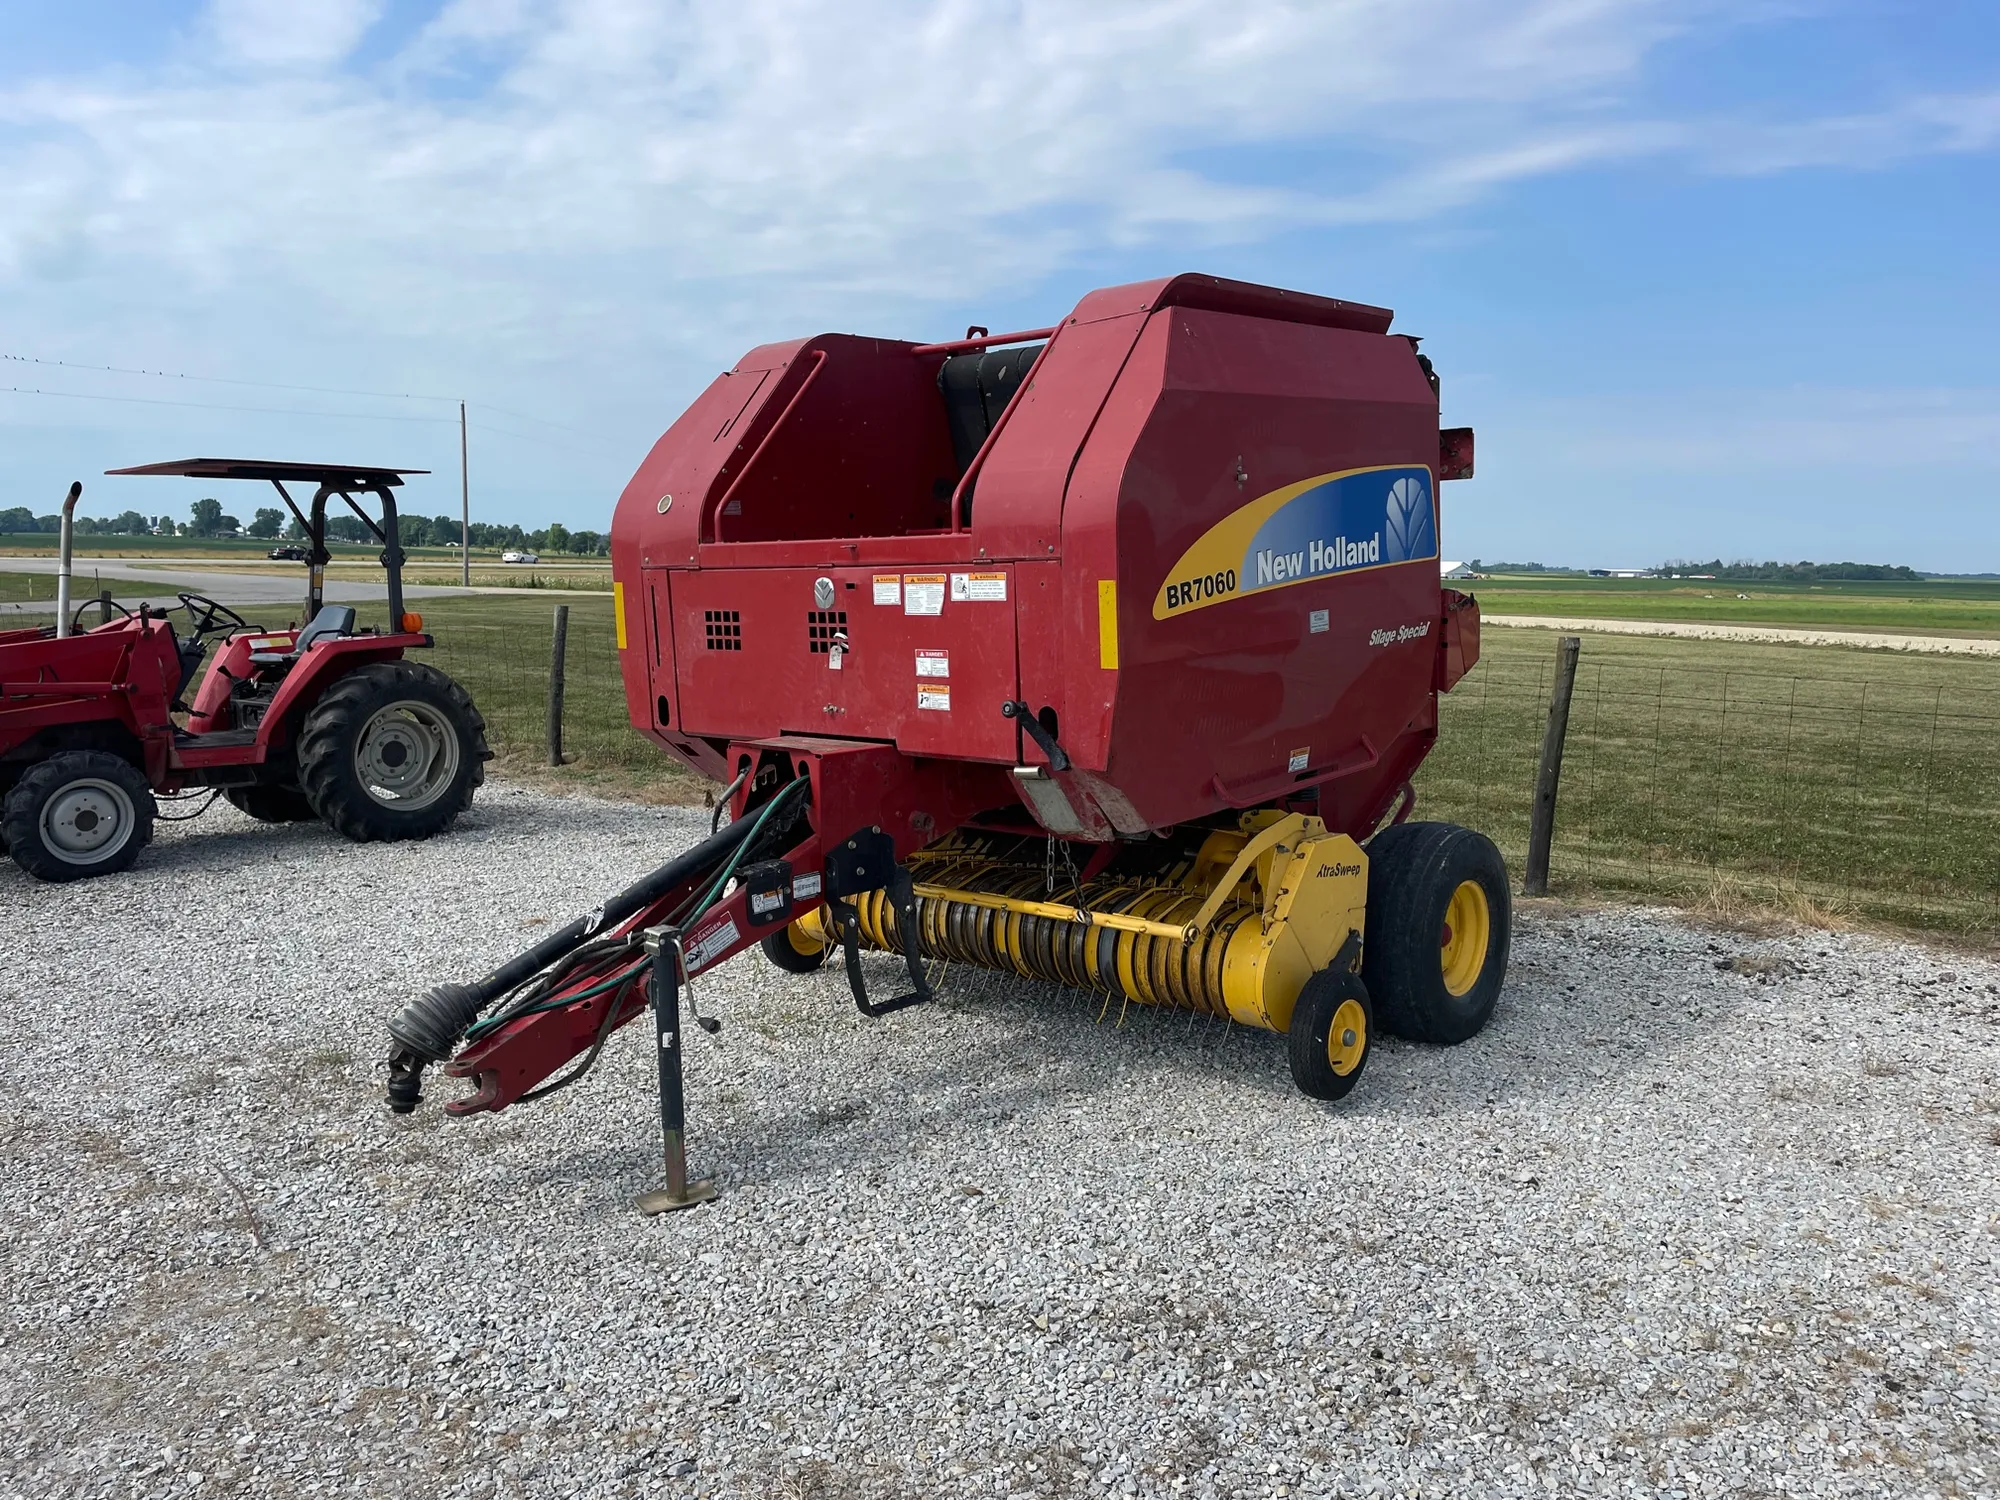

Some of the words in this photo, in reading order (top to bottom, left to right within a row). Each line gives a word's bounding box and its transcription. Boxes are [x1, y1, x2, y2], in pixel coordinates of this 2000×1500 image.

[1256, 549, 1303, 585] New
[1309, 532, 1380, 574] Holland
[1165, 568, 1236, 610] BR7060
[1368, 629, 1396, 648] Silage
[1397, 621, 1431, 645] Special
[1316, 862, 1361, 879] XtraSweep
[697, 921, 722, 942] DANGER
